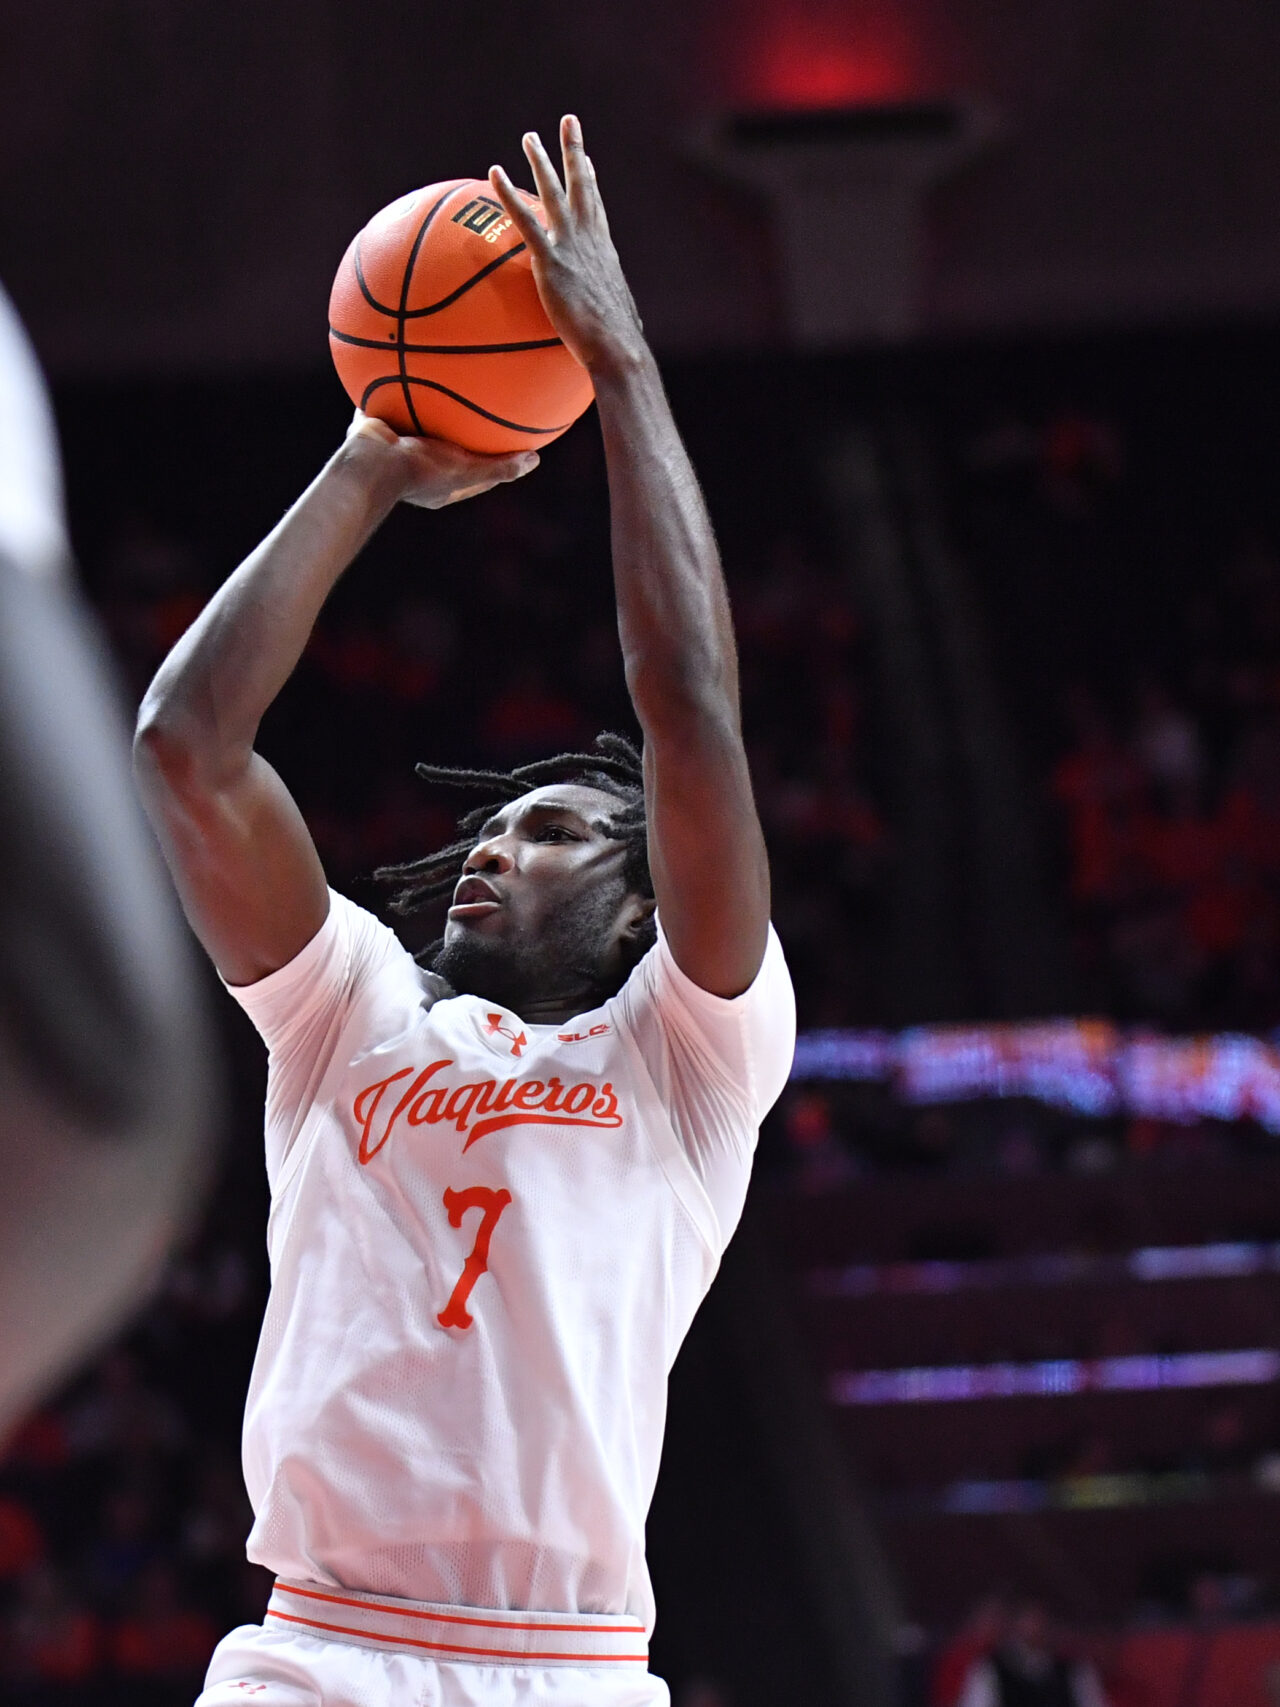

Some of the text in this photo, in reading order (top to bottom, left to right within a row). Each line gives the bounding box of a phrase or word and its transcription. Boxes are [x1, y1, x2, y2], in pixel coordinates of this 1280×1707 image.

[558, 1024, 608, 1042] SLC
[353, 1059, 623, 1166] Vaqueros
[437, 1186, 513, 1330] 7
